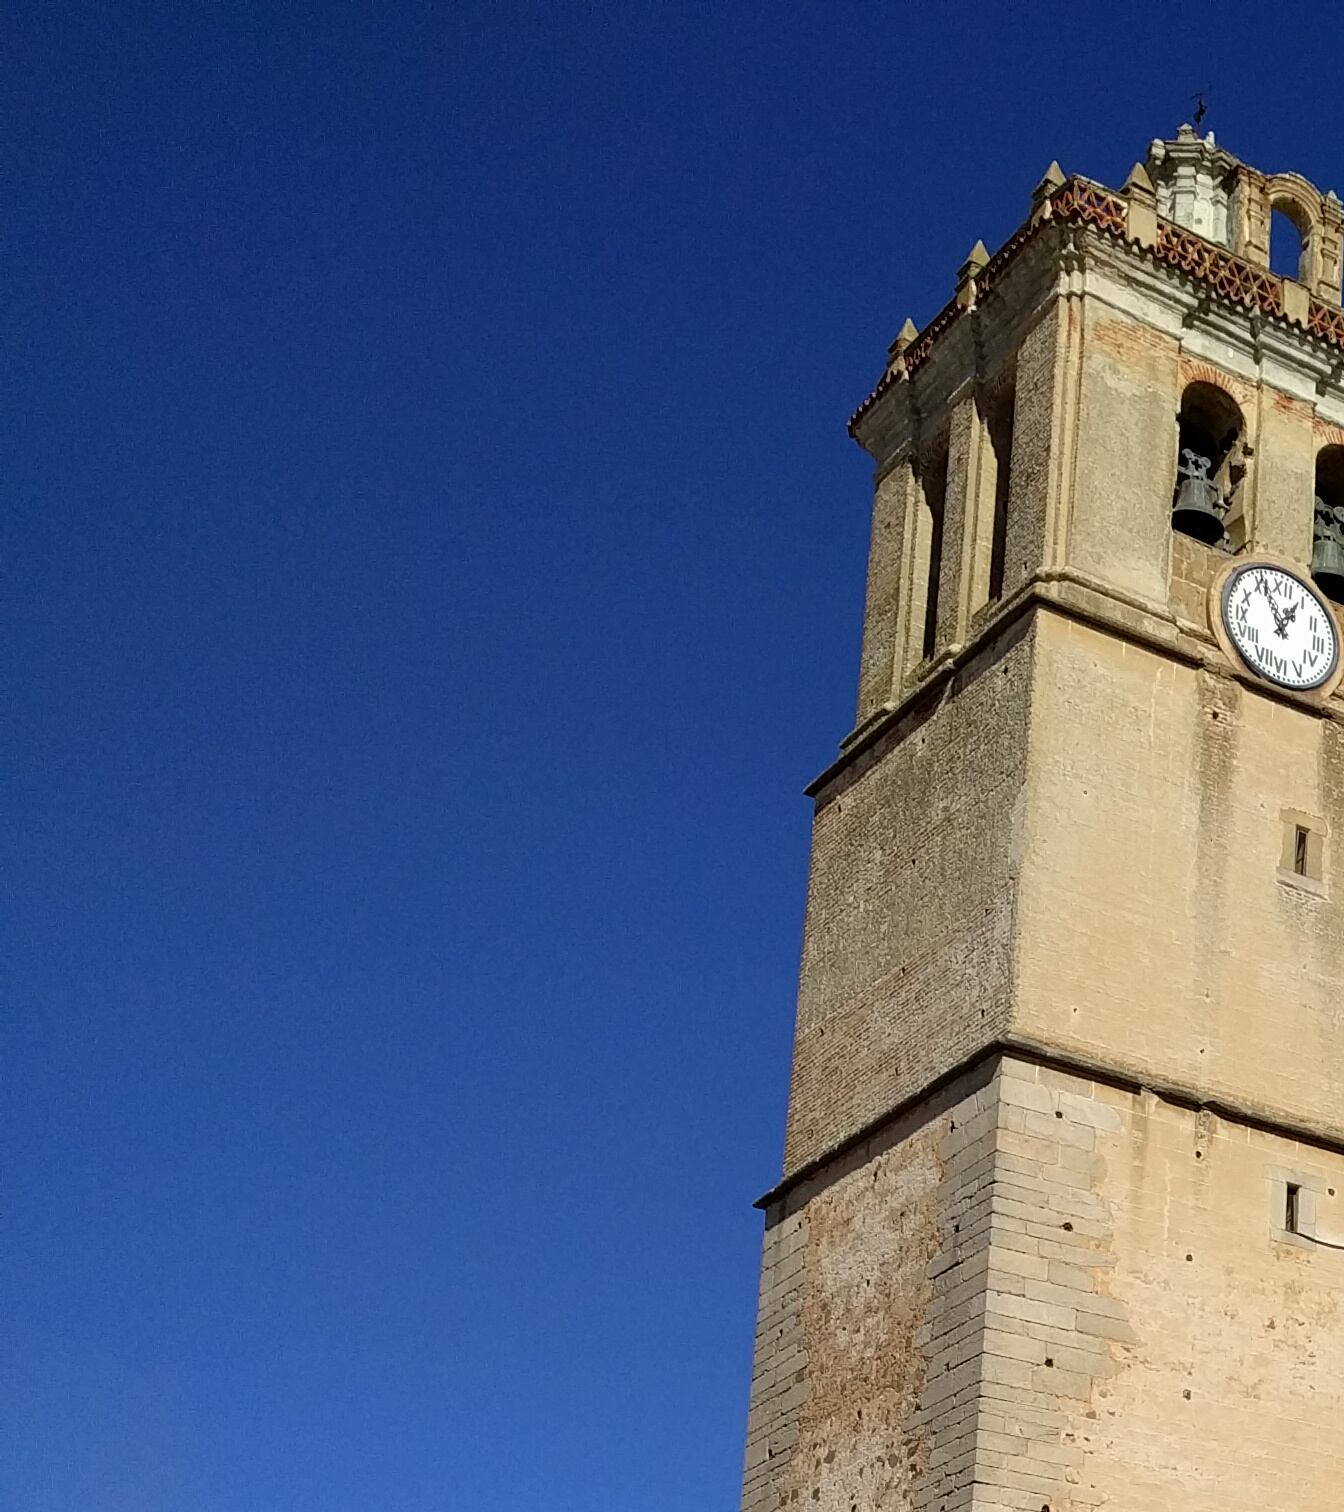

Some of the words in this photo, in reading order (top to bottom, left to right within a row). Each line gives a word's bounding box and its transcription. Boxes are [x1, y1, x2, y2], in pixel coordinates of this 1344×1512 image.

[1242, 588, 1252, 606] X
[1273, 578, 1292, 599] XII
[1236, 604, 1248, 623] IX
[1238, 622, 1259, 643] VIII
[1309, 616, 1317, 632] II
[1312, 634, 1324, 654] III
[1255, 645, 1273, 666] VII
[1303, 649, 1318, 667] IV
[1274, 656, 1287, 676] VI
[1292, 660, 1303, 678] V
